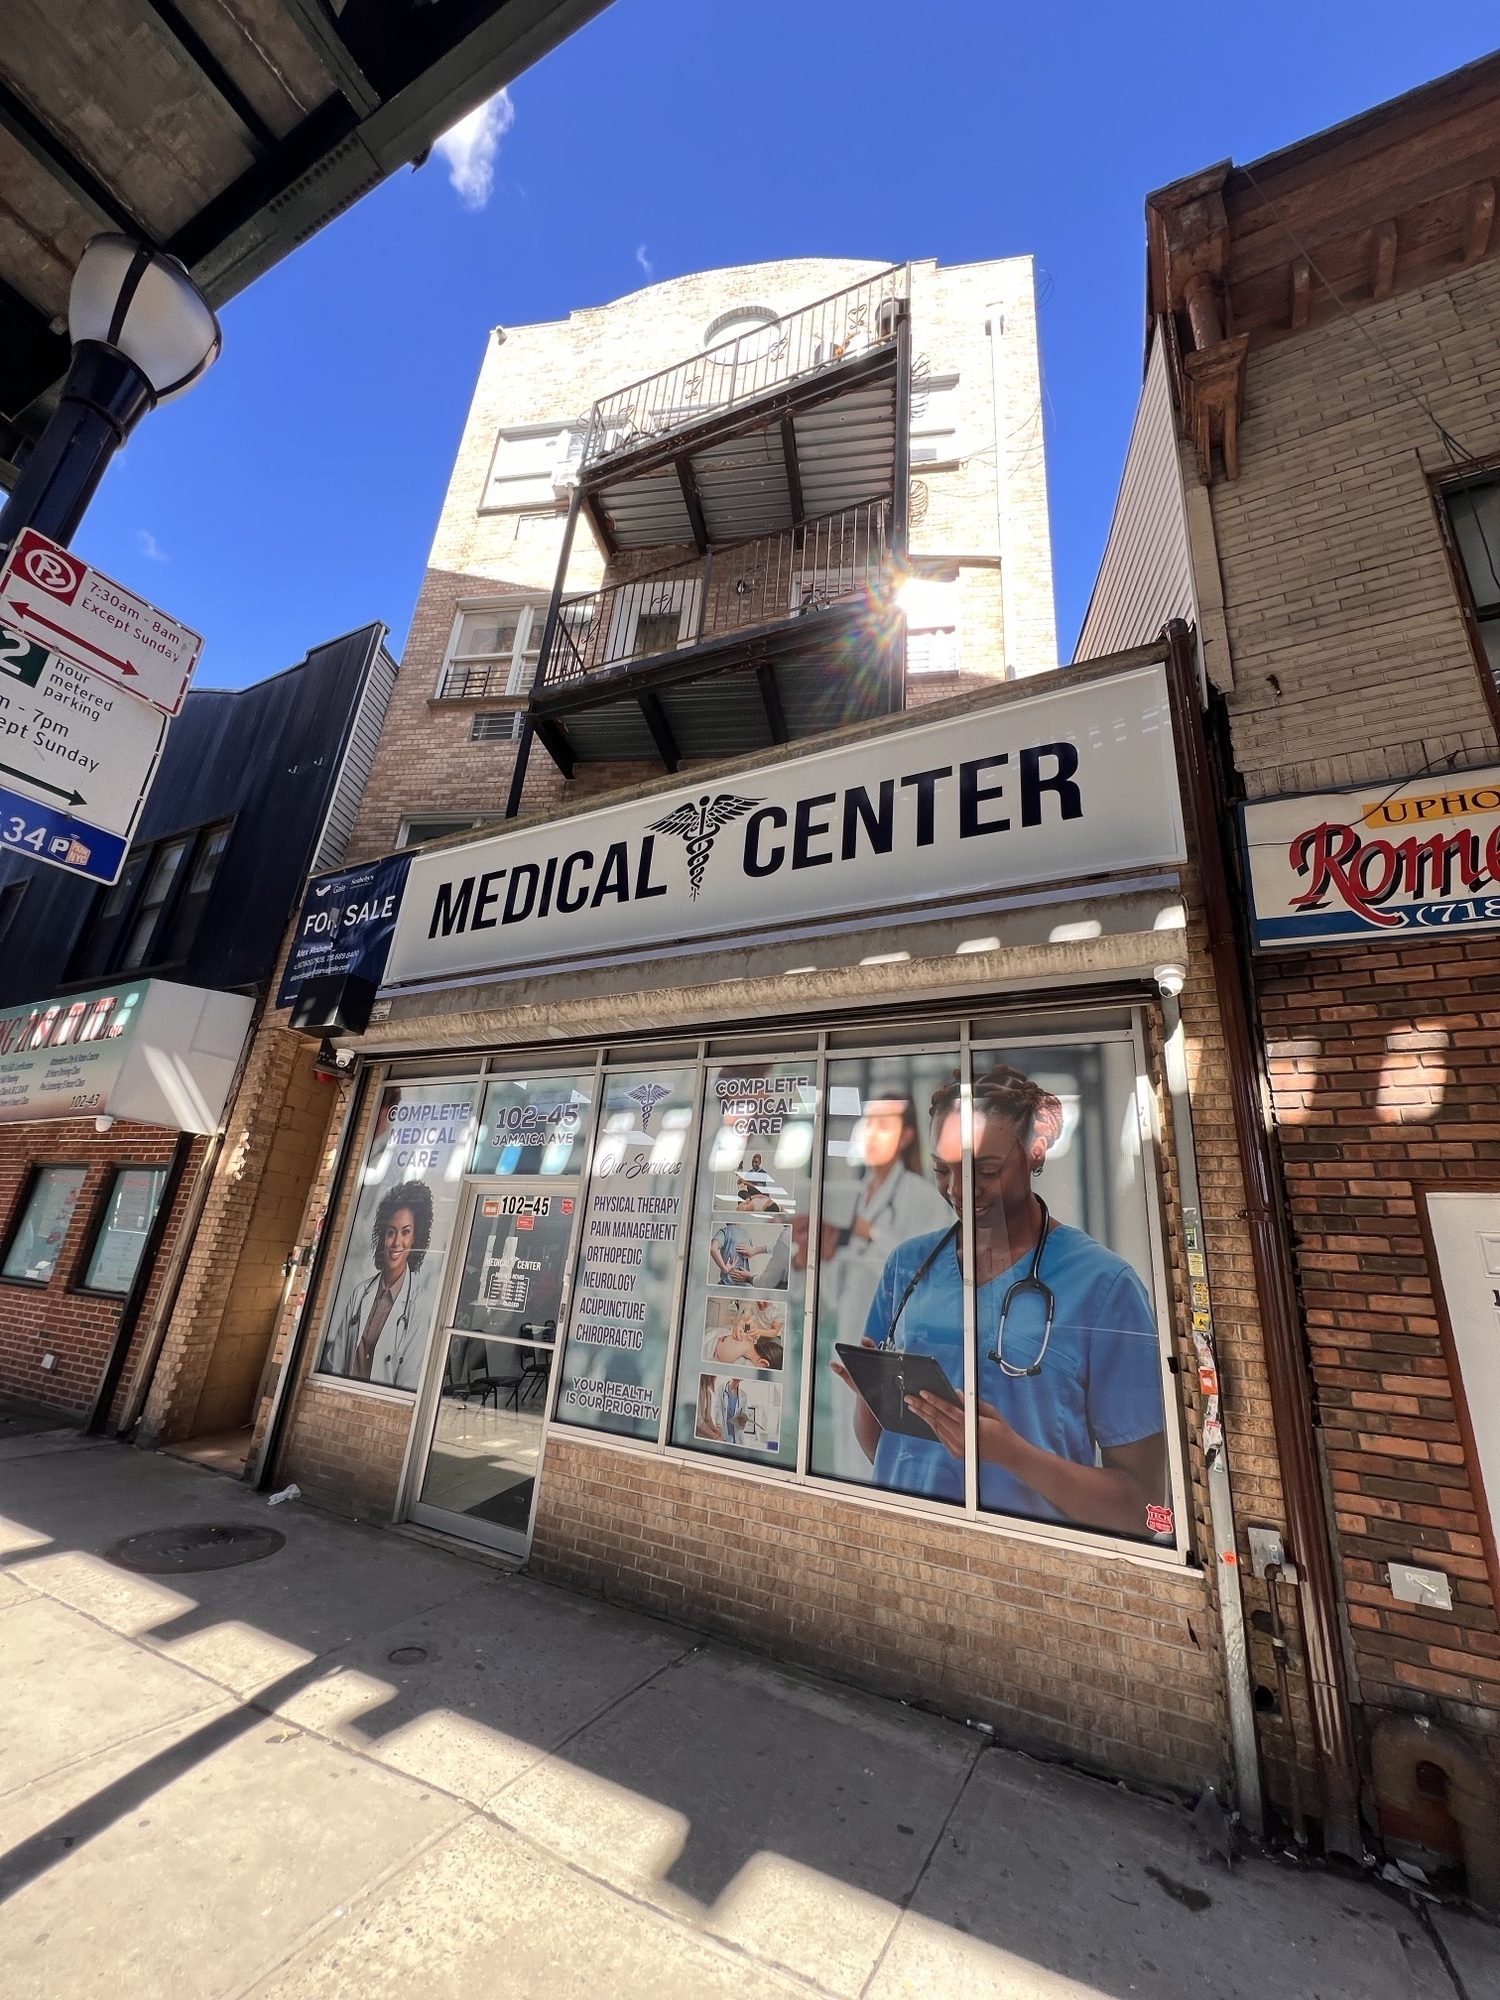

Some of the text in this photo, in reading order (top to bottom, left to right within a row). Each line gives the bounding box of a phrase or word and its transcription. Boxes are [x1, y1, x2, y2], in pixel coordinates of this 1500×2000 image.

[89, 581, 140, 620] 7:30am
[152, 621, 180, 645] 8am
[81, 597, 180, 664] Except Sunday
[0, 630, 30, 675] 2
[55, 659, 90, 684] hour
[43, 686, 101, 722] parking
[49, 673, 114, 712] metered
[32, 708, 69, 738] 7pm
[33, 731, 100, 774] Sunday
[427, 741, 1086, 940] MEDICAL CENTER
[343, 895, 396, 927] SALE
[714, 1077, 809, 1097] COMPLETE
[68, 1094, 101, 1110] 102-43
[387, 1102, 471, 1123] COMPLETE
[721, 1098, 798, 1116] MEDICAL
[495, 1102, 580, 1130] 102-45
[735, 1117, 783, 1136] CARE
[389, 1127, 456, 1146] MEDICAL
[491, 1132, 574, 1147] JAMAICA AVE
[396, 1150, 439, 1169] CARE
[600, 1153, 684, 1180] Our Services
[502, 1195, 550, 1217] 102-45
[593, 1196, 636, 1214] PHYSICAL
[637, 1197, 680, 1215] THERAPY
[590, 1221, 678, 1241] PAIN MANAGEMENT
[516, 1260, 542, 1272] CENTER
[586, 1245, 643, 1266] ORTHOPEDIC
[583, 1271, 637, 1292] NEUROLOGY
[502, 1300, 520, 1308] CLOSED
[579, 1297, 646, 1321] ACUPUNCTURE
[575, 1323, 644, 1350] CHIROPRACTIC
[572, 1377, 654, 1403] YOUR HEALTH
[565, 1391, 660, 1421] IS OUR PRIORITY
